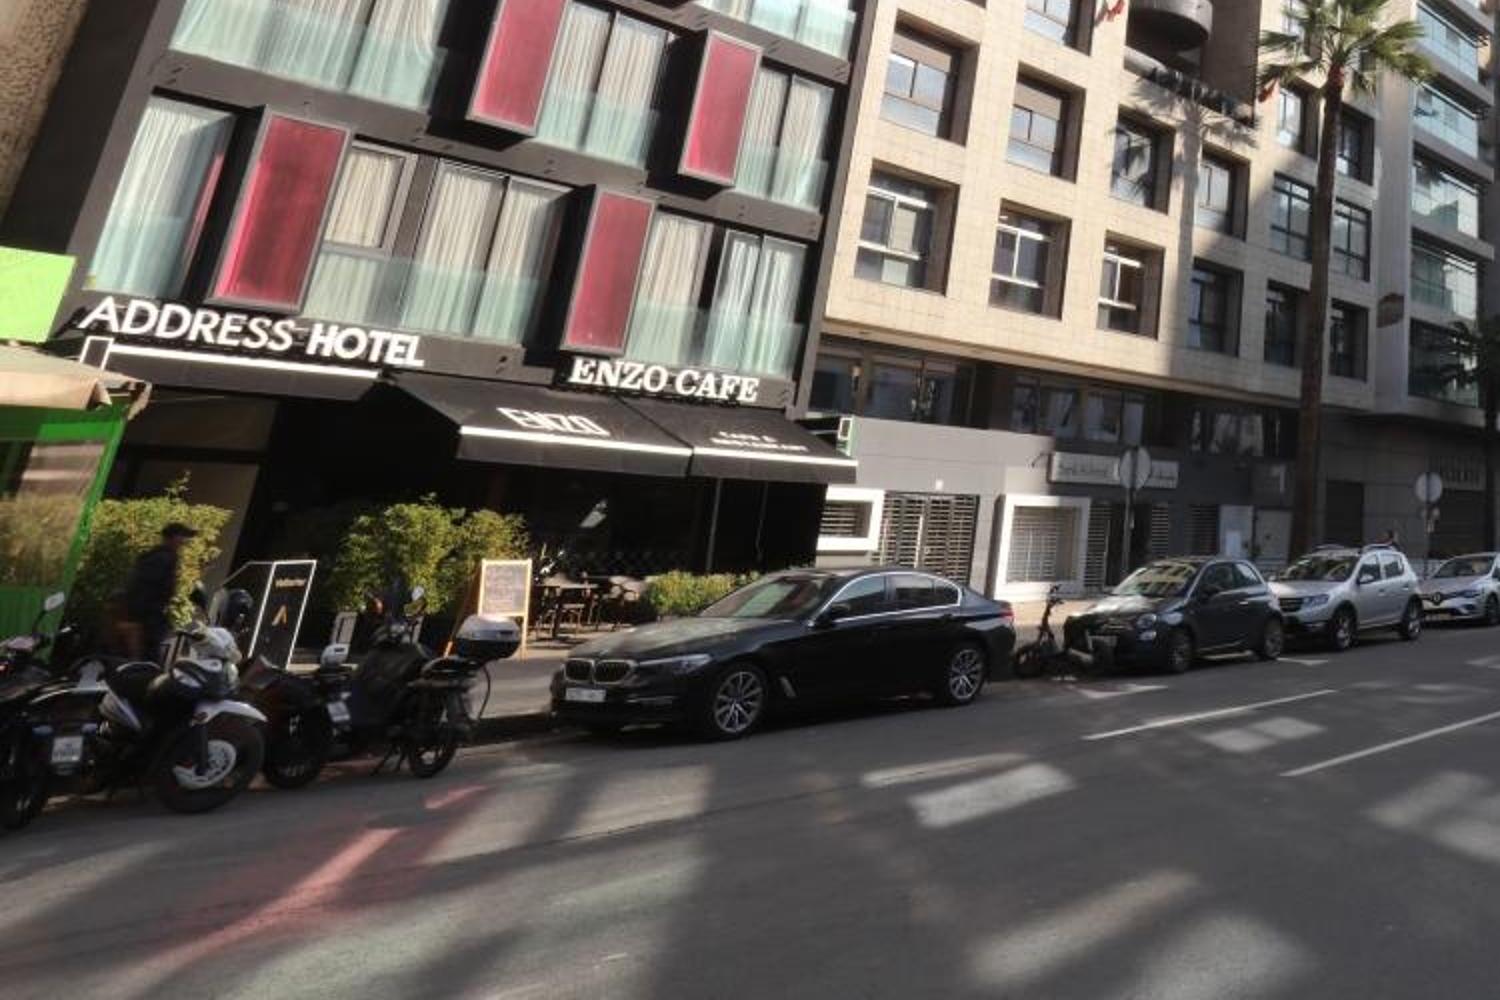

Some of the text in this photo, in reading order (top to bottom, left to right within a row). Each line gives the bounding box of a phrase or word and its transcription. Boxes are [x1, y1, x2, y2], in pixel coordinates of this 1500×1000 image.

[78, 295, 425, 368] ADDRESS HOTEL
[568, 356, 760, 402] ENZO CAFE
